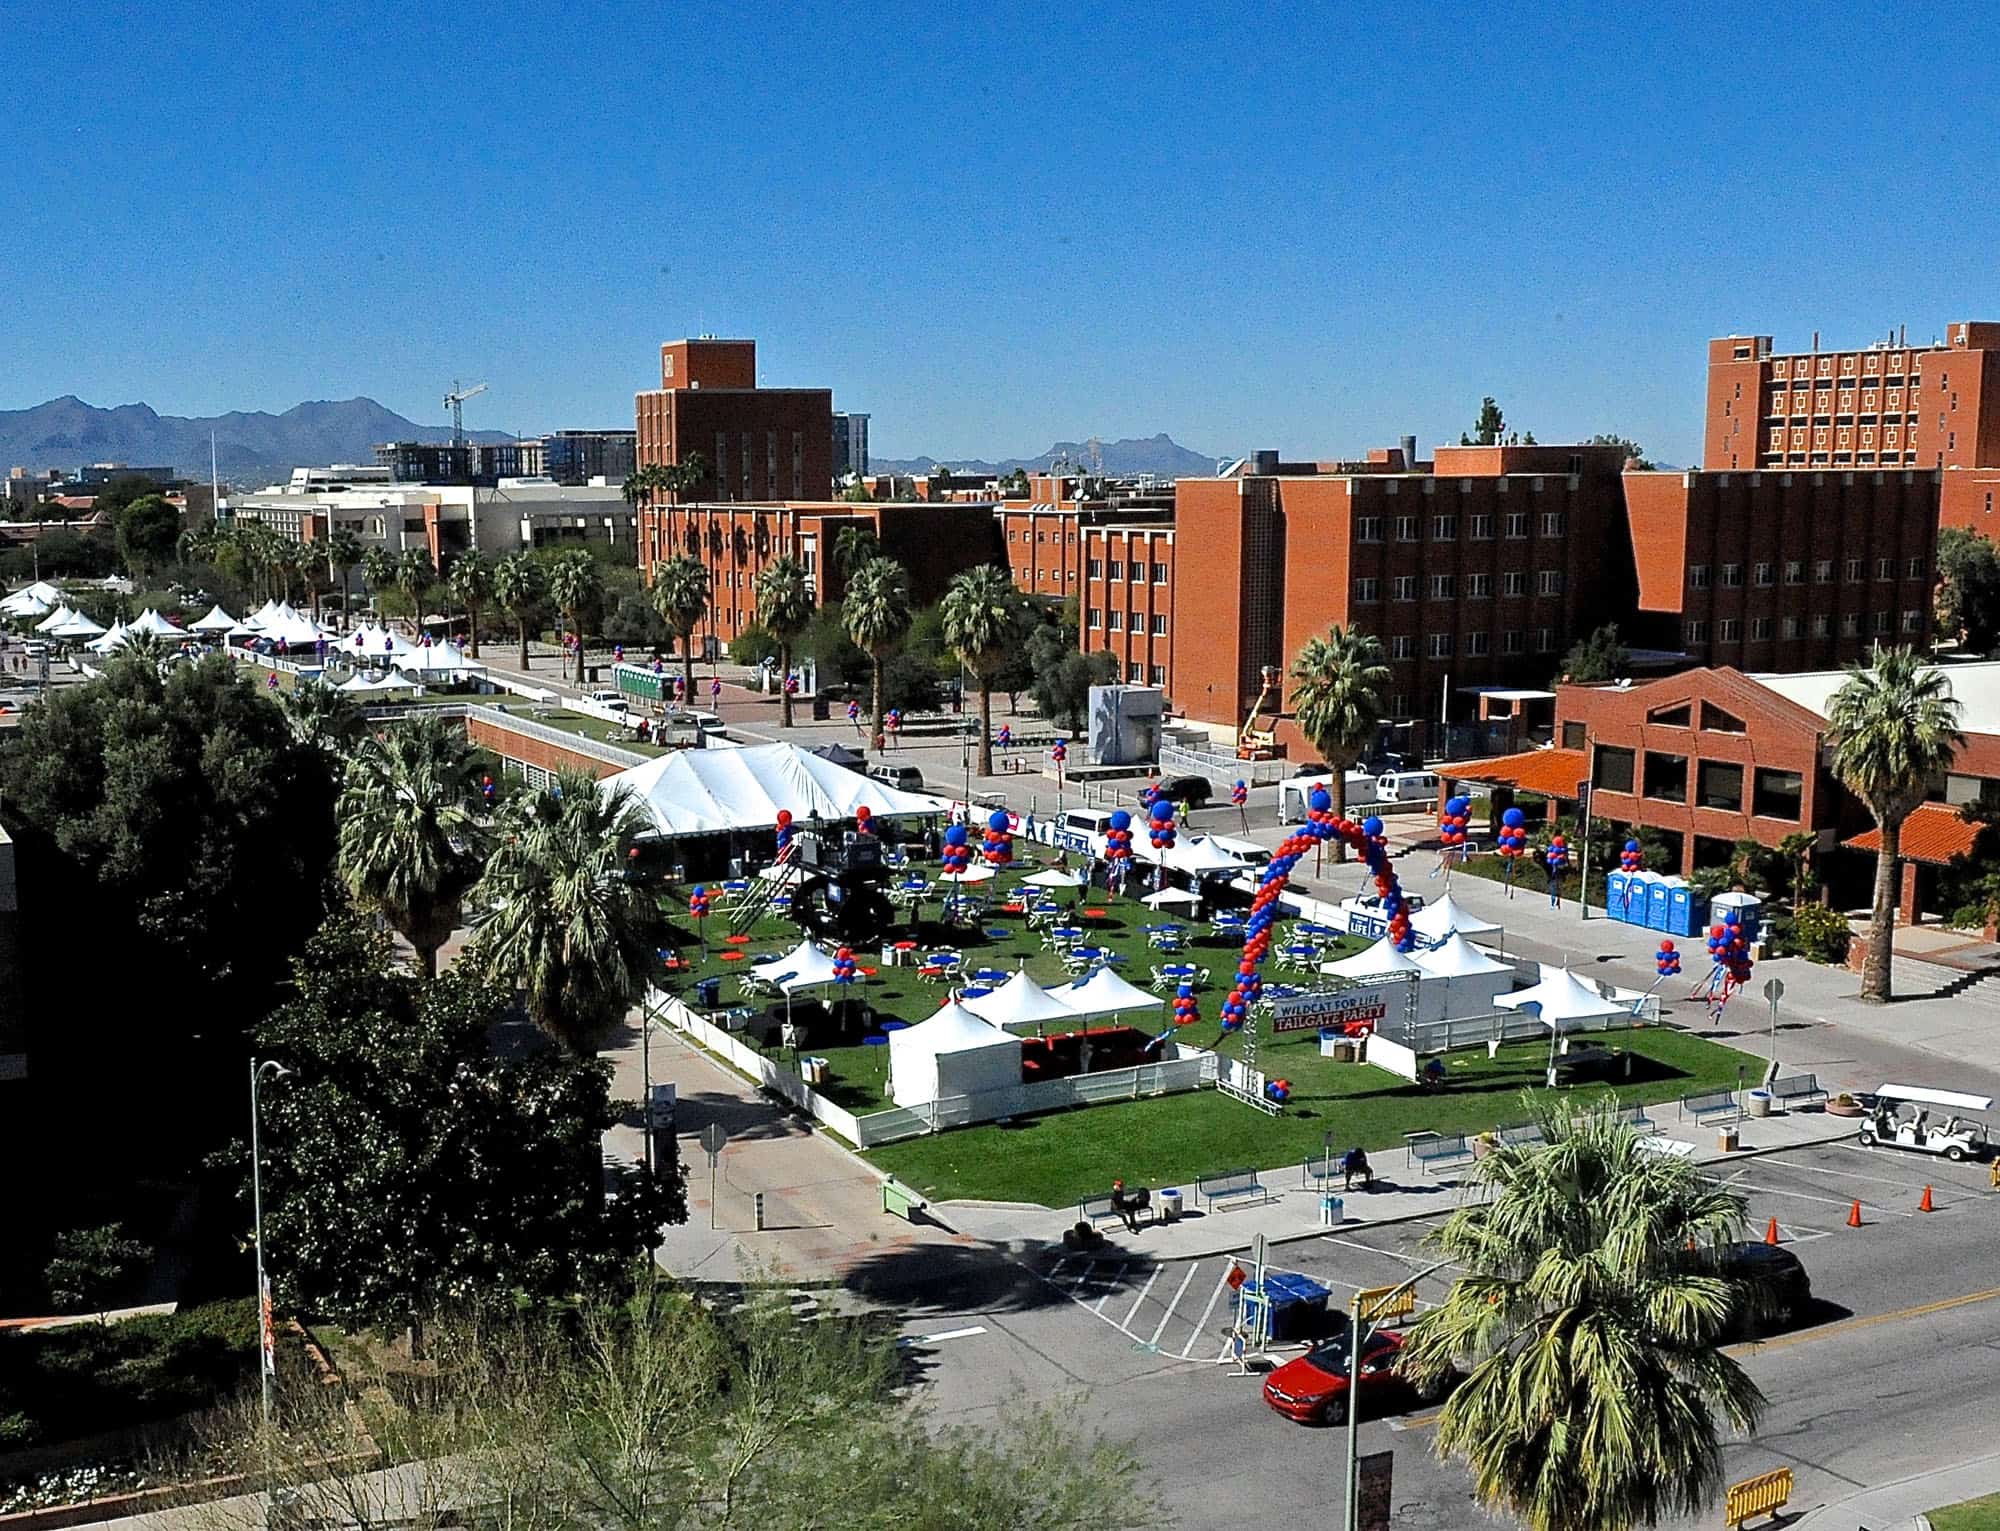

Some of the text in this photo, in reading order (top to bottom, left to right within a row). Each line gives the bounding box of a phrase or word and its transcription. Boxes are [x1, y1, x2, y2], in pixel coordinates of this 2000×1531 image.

[1277, 1004, 1384, 1030] TAILGATE PARTY
[1281, 994, 1380, 1016] WILDCAT FOR LIFE
